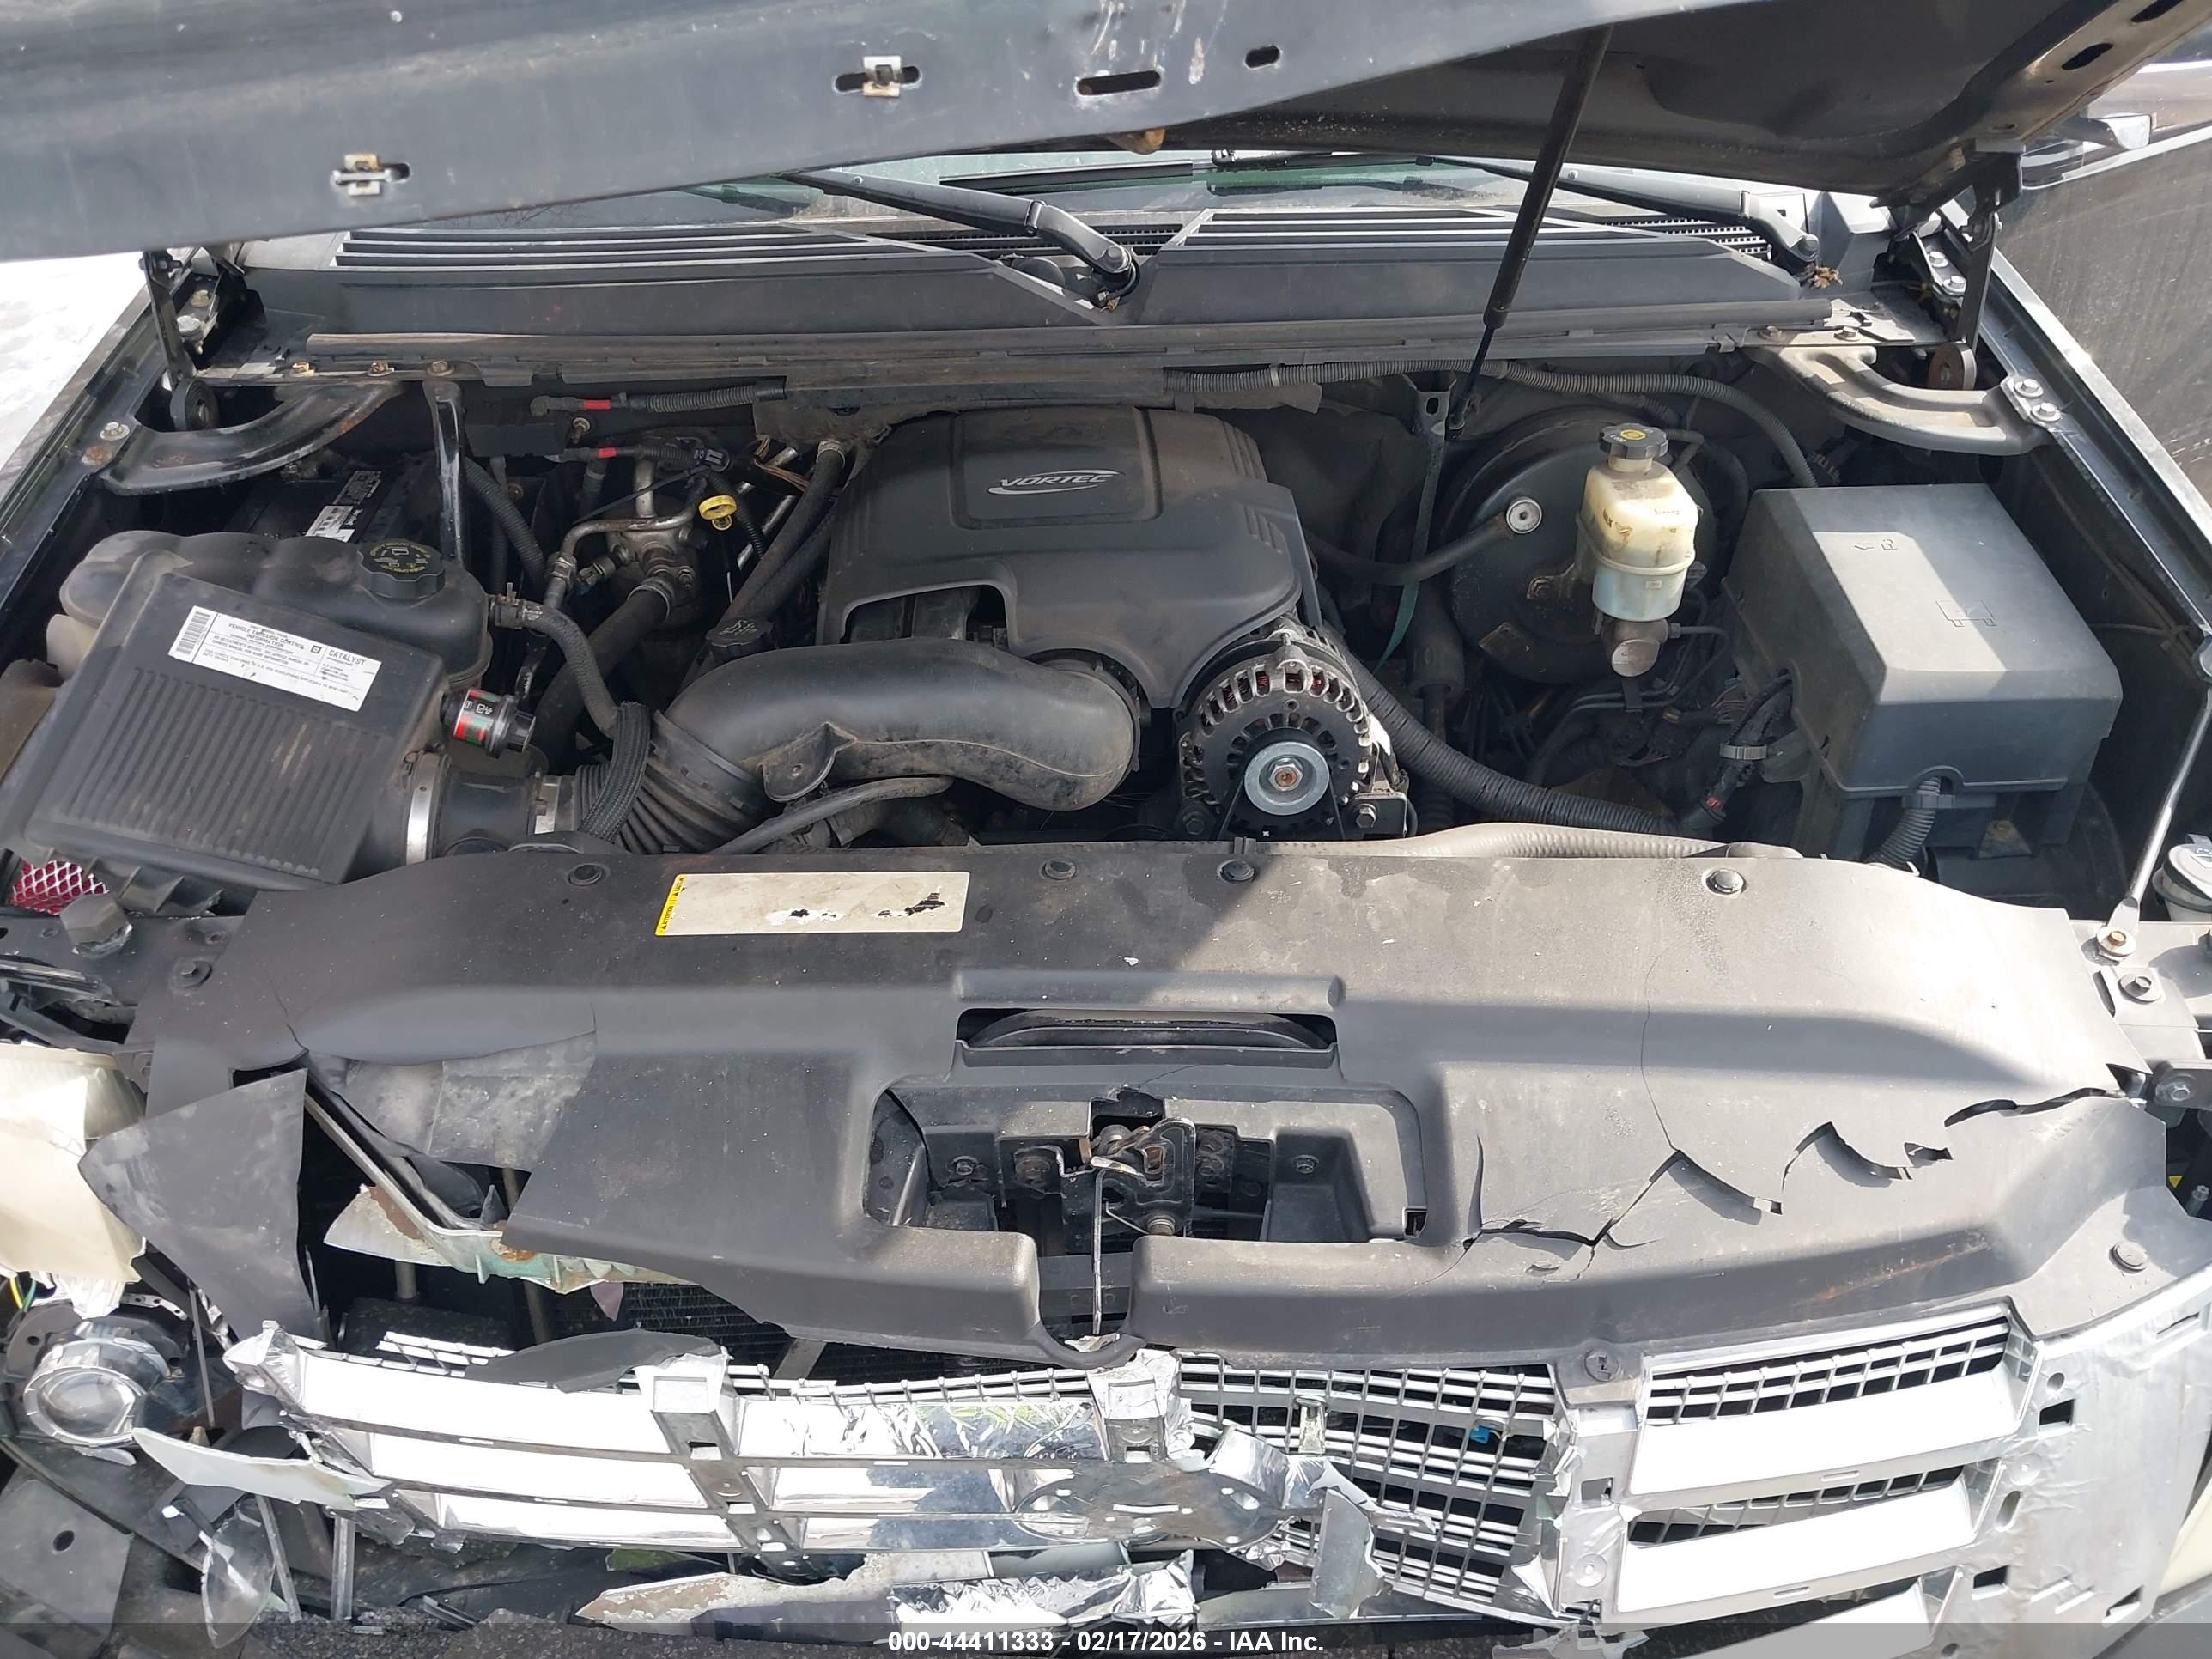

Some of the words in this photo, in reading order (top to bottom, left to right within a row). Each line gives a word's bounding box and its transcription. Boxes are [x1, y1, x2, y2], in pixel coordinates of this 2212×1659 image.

[1000, 474, 1114, 487] VORTEC
[228, 622, 251, 633] VEHICLE
[251, 629, 279, 641] EMISSION
[279, 637, 306, 650] CONTROL
[246, 633, 284, 647] INFORMATION
[327, 649, 366, 666] CATALYST
